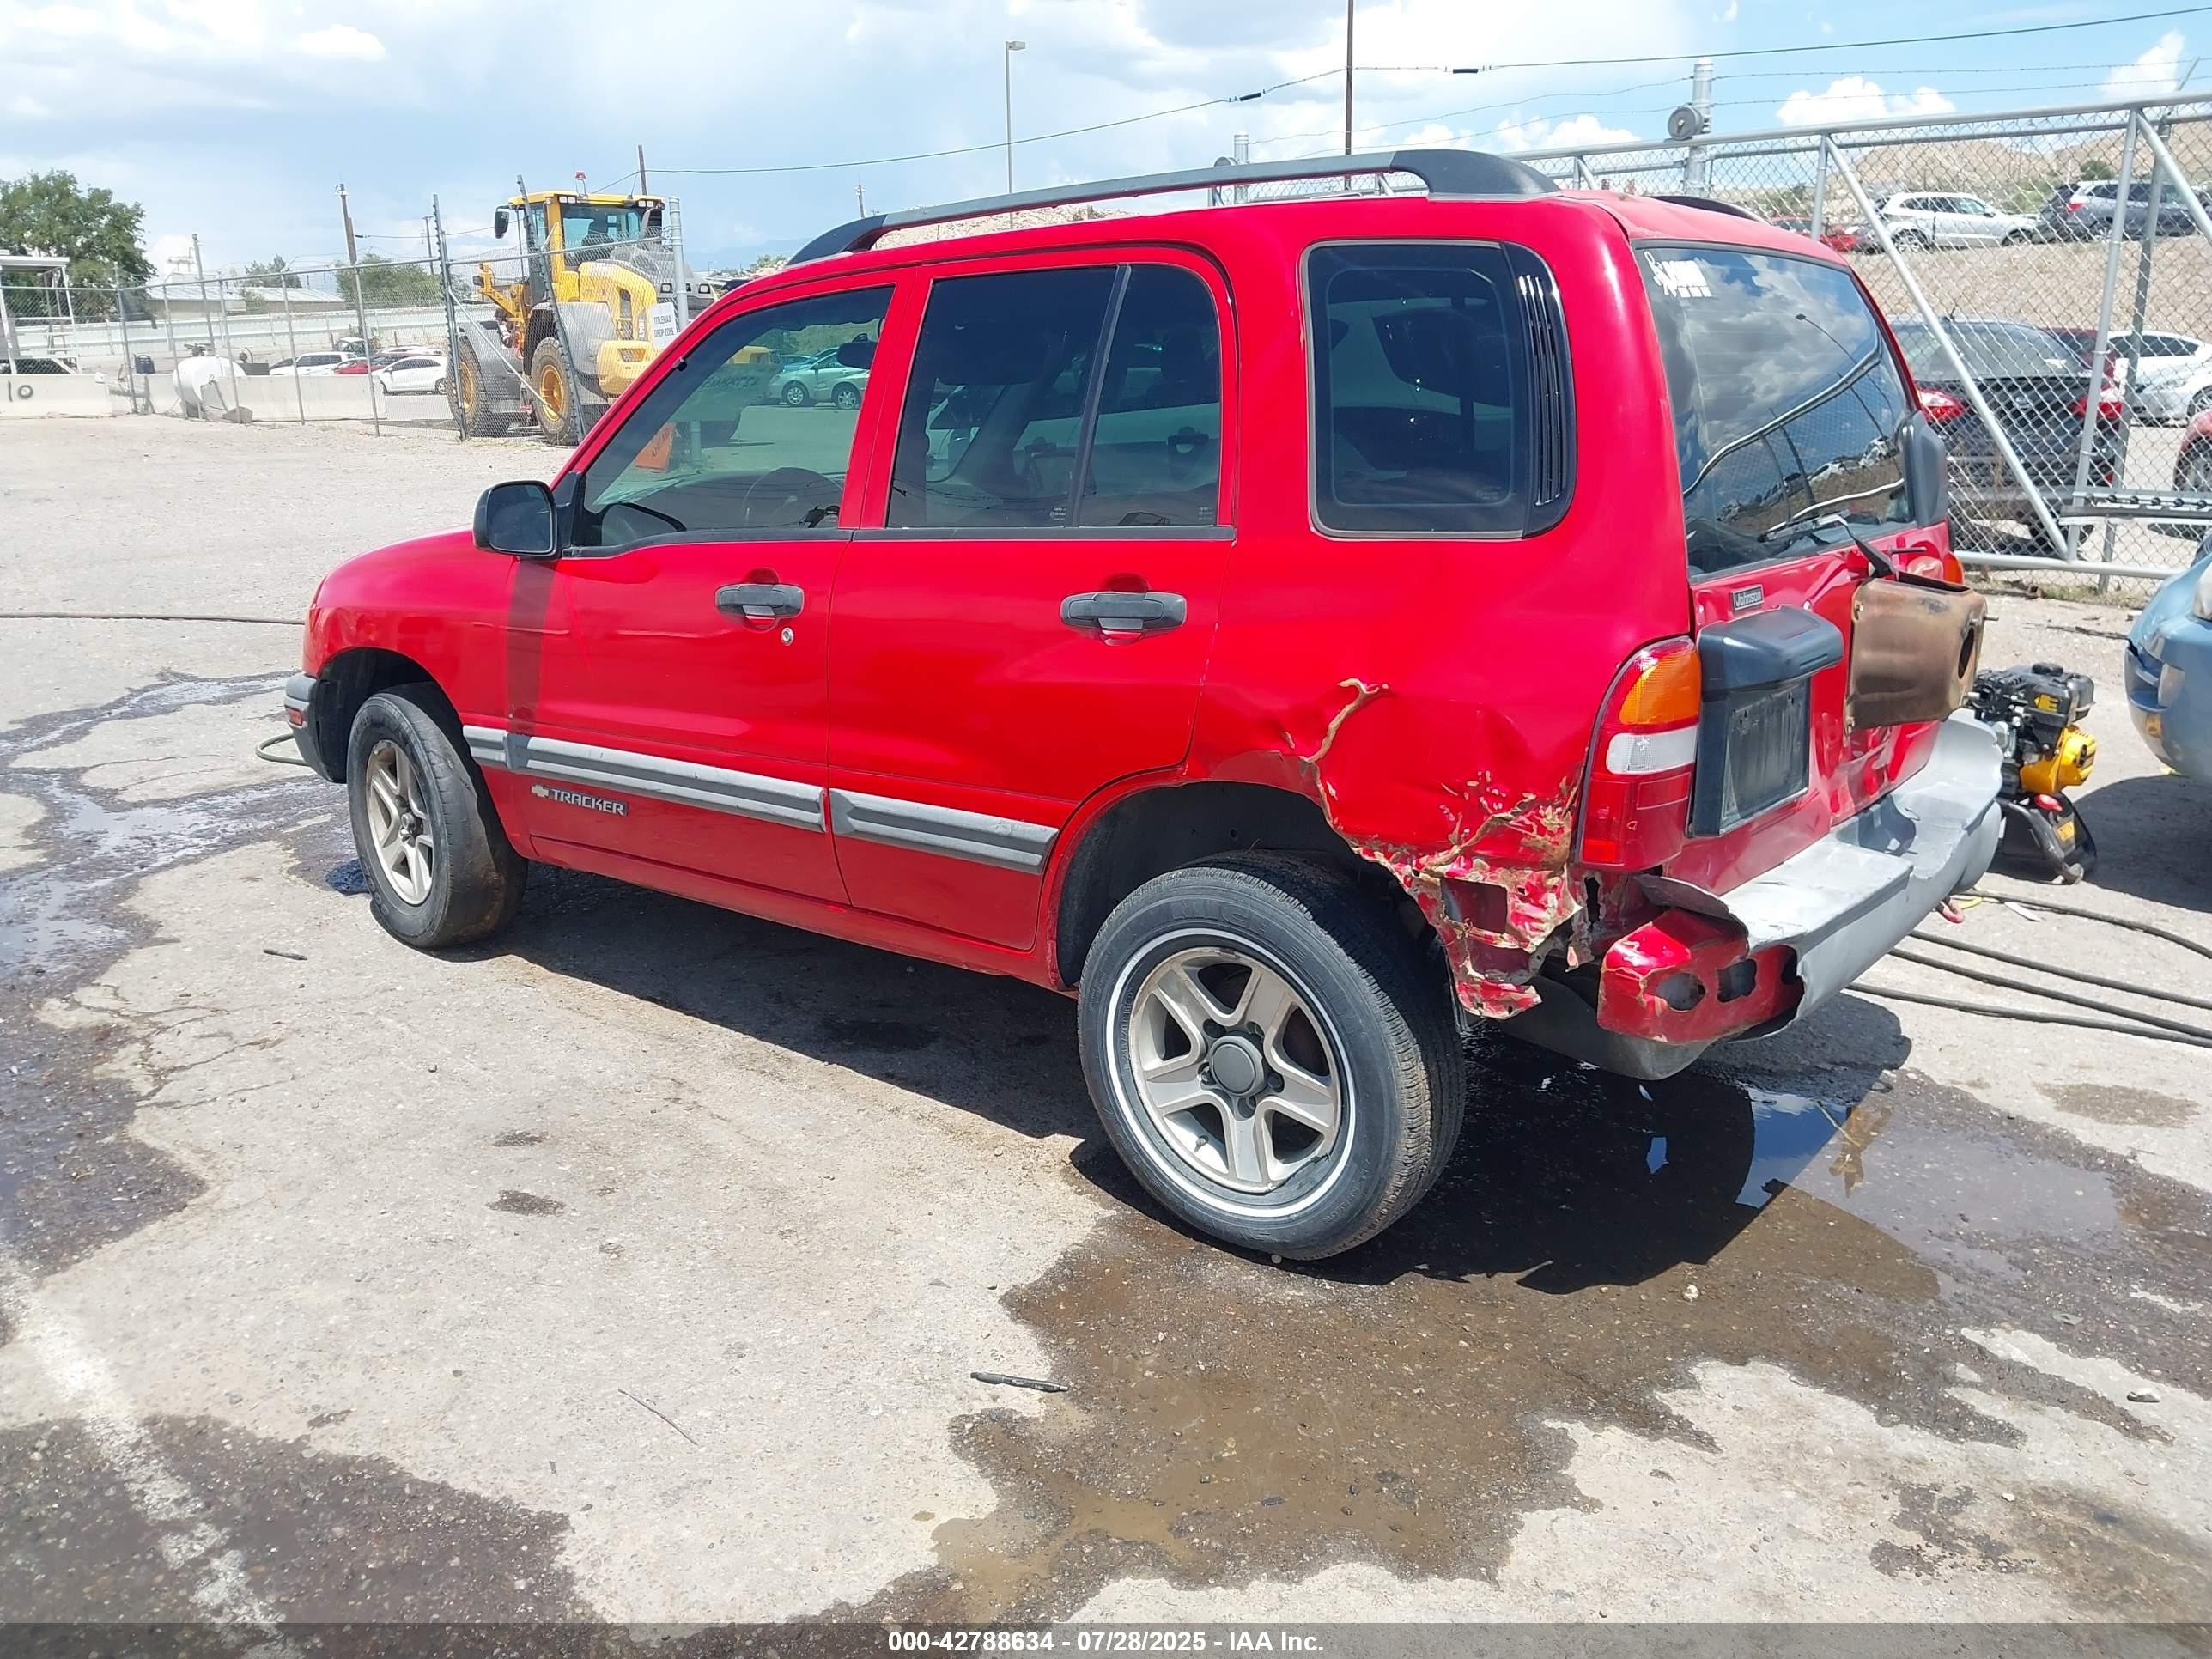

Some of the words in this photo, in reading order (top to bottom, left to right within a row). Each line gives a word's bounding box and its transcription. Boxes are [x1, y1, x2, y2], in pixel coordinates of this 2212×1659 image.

[653, 315, 672, 325] TITLEMAX
[653, 329, 665, 337] DROP
[665, 327, 675, 337] ZONE
[8, 380, 33, 402] 10
[1735, 590, 1763, 607] Johnson
[551, 788, 627, 816] TRACKER
